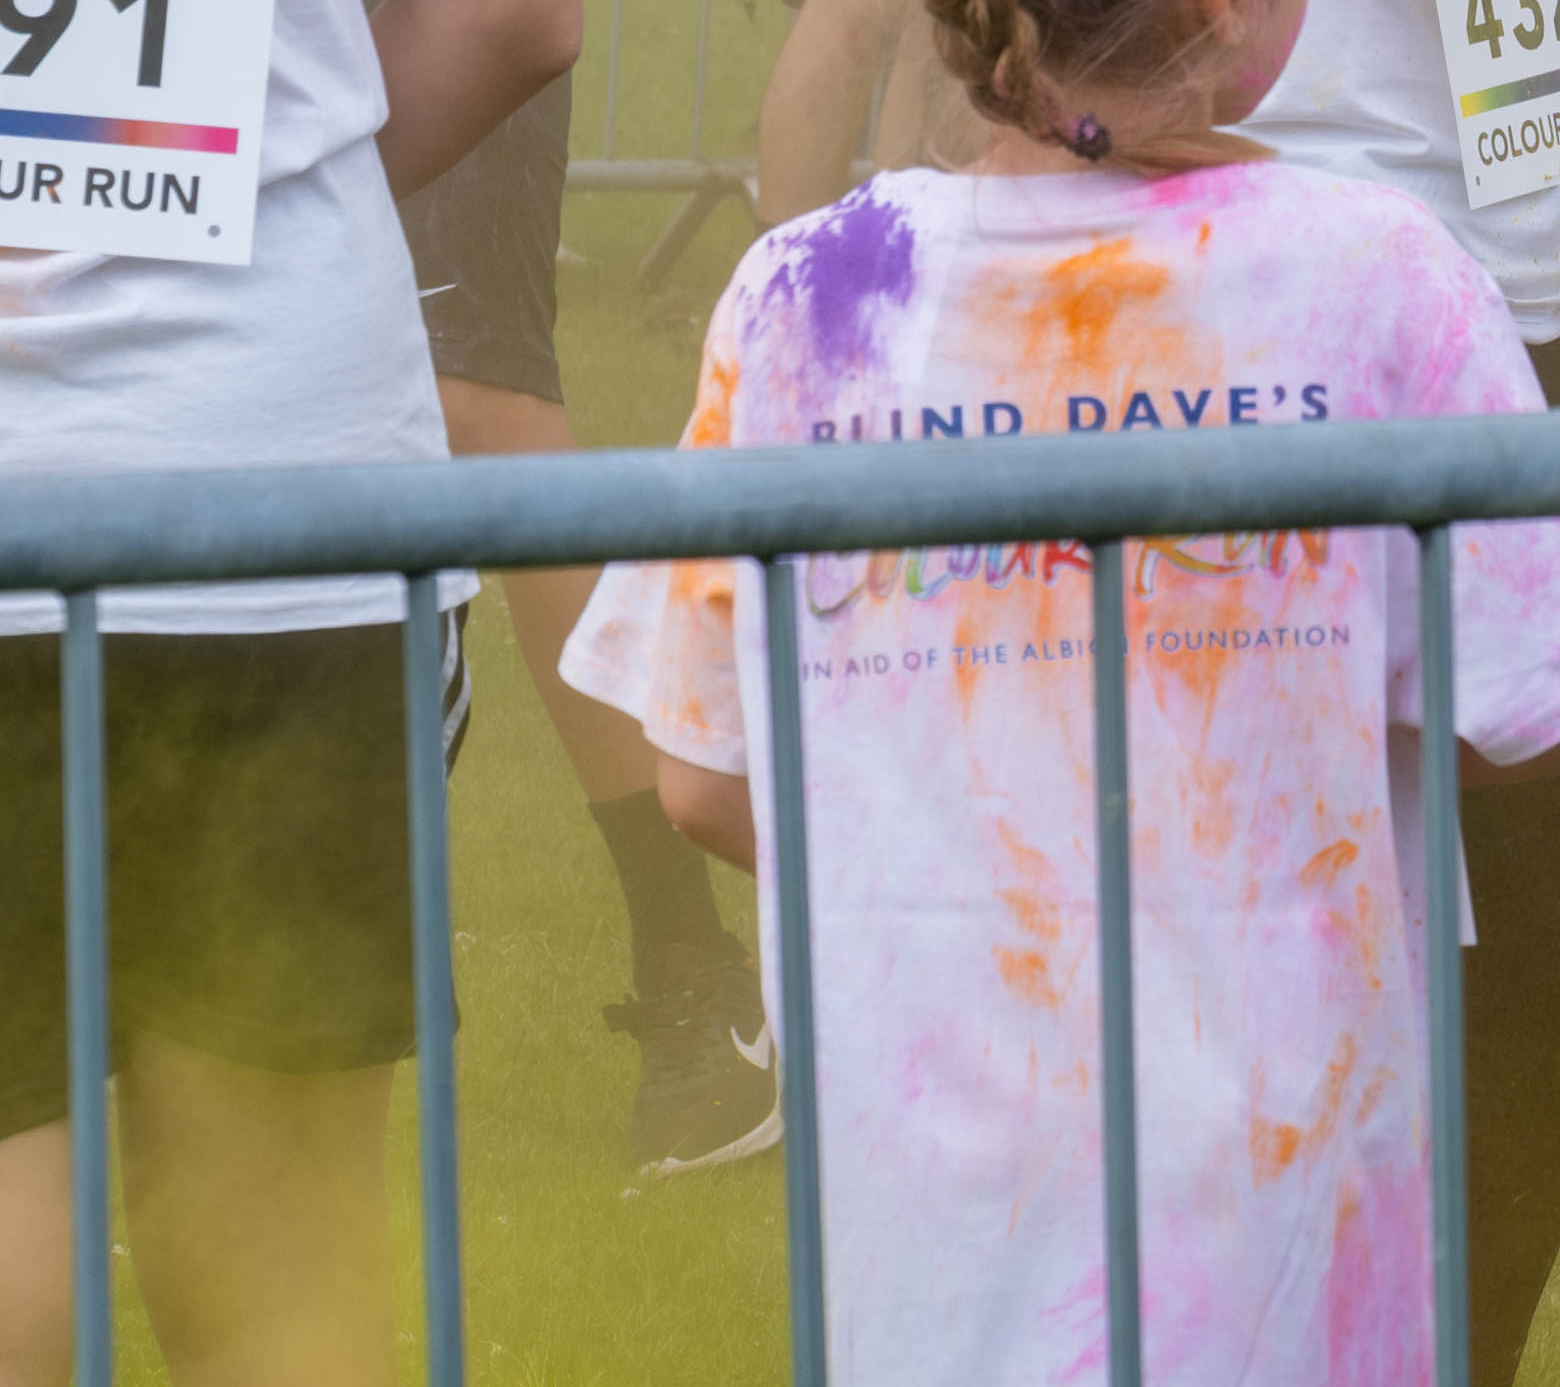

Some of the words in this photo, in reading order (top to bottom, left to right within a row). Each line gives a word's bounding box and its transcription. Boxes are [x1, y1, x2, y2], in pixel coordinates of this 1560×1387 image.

[83, 168, 202, 216] RUN
[801, 658, 832, 682] IN
[844, 652, 891, 676] AID
[903, 648, 942, 671] OF
[951, 643, 1008, 668] THE
[1146, 624, 1351, 653] FOUNDATION
